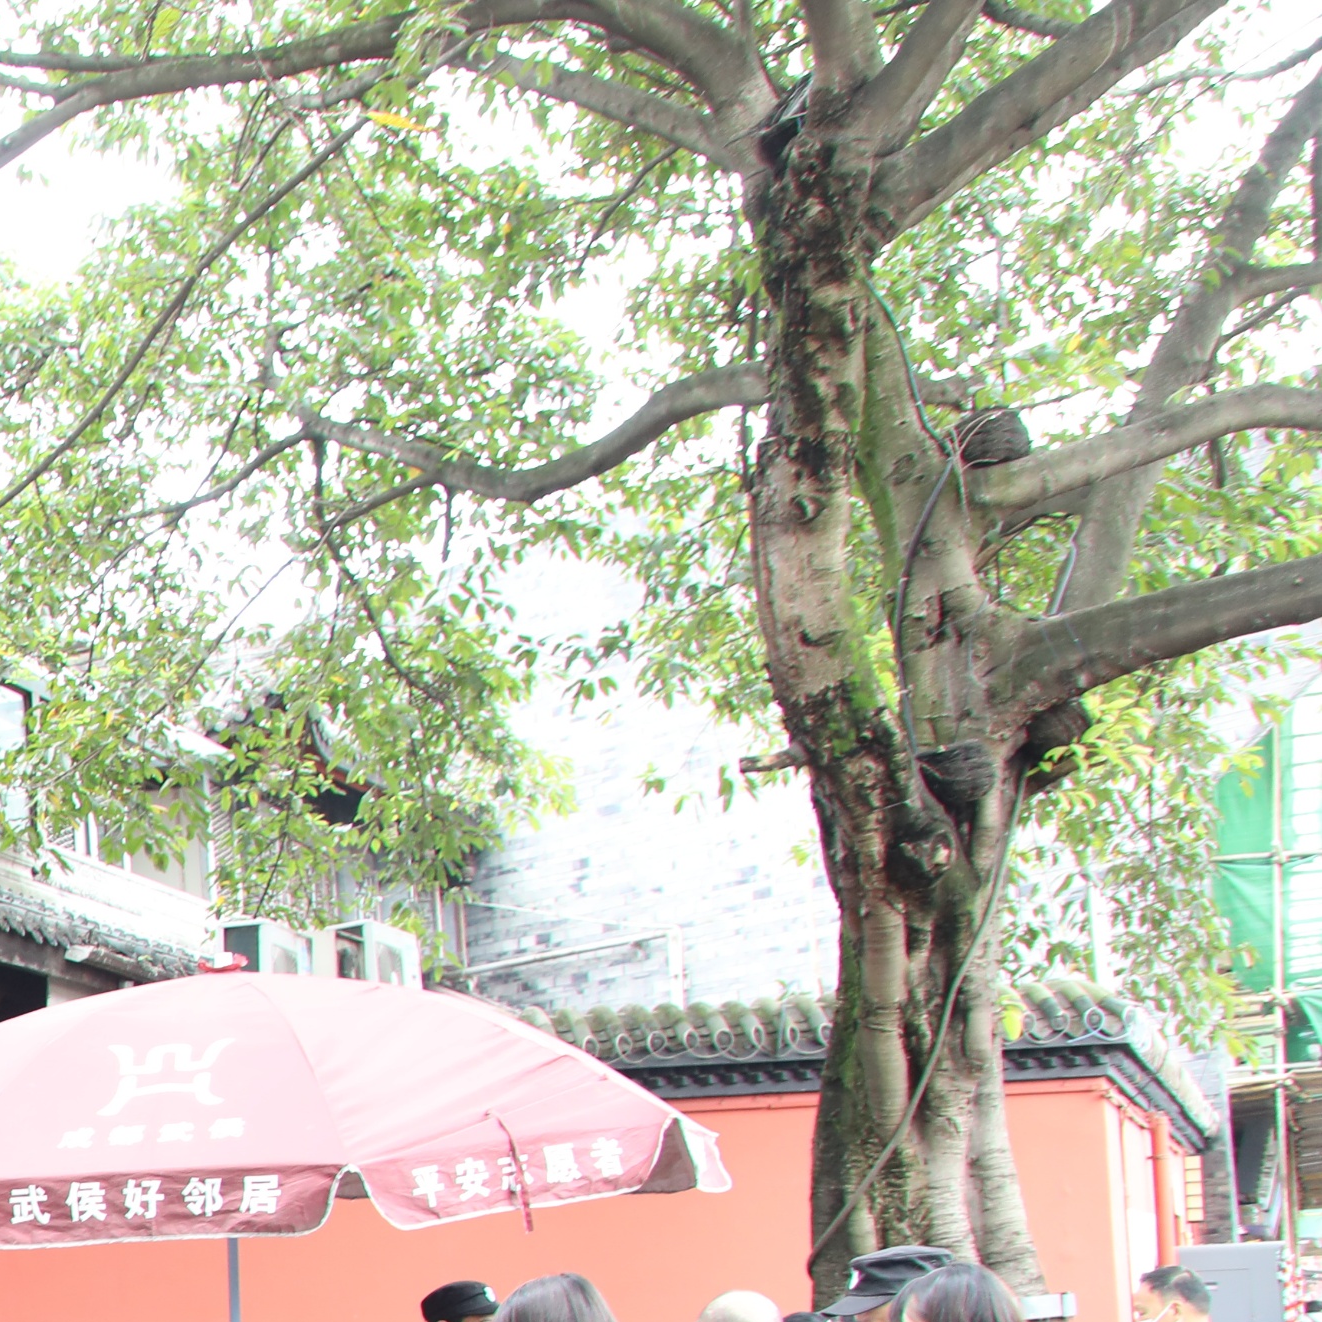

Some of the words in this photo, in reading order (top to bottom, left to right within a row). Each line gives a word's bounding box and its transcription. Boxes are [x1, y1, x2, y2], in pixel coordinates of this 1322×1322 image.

[8, 1173, 283, 1226] 武侯好邻居
